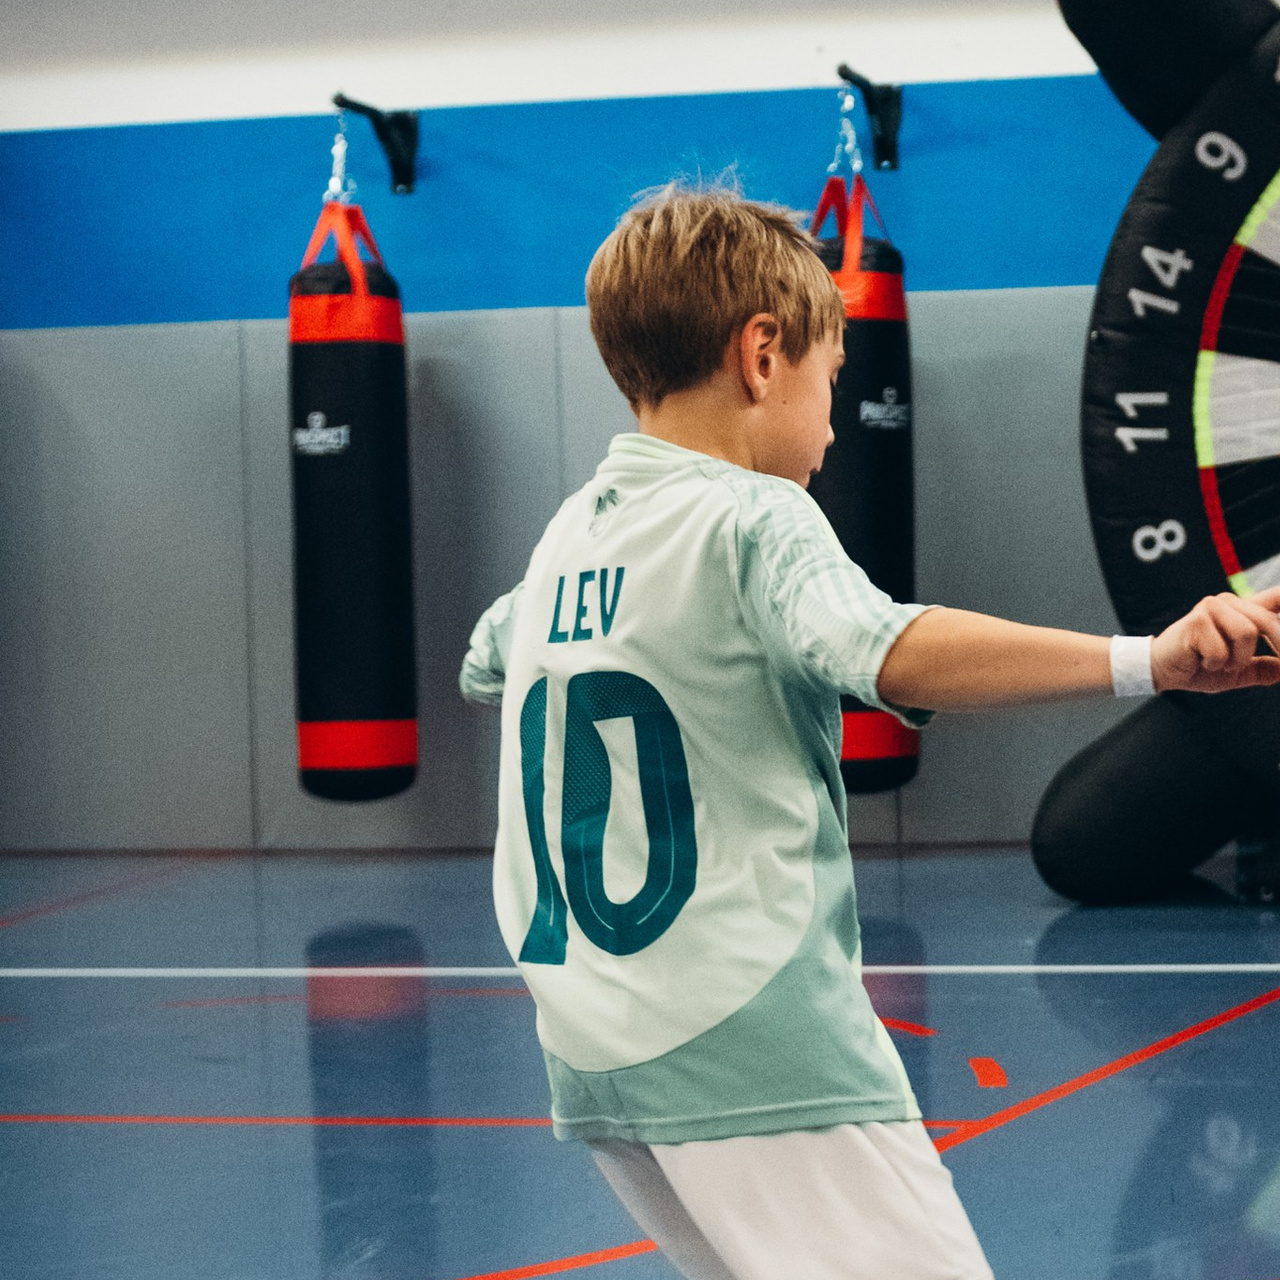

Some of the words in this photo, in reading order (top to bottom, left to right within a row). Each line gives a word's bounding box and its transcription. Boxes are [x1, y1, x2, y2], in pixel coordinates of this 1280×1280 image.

[1194, 131, 1248, 181] 9
[1127, 245, 1193, 317] 14
[1114, 392, 1169, 453] 11
[1132, 519, 1187, 562] 8
[547, 566, 625, 643] LEV
[518, 671, 697, 964] 10
